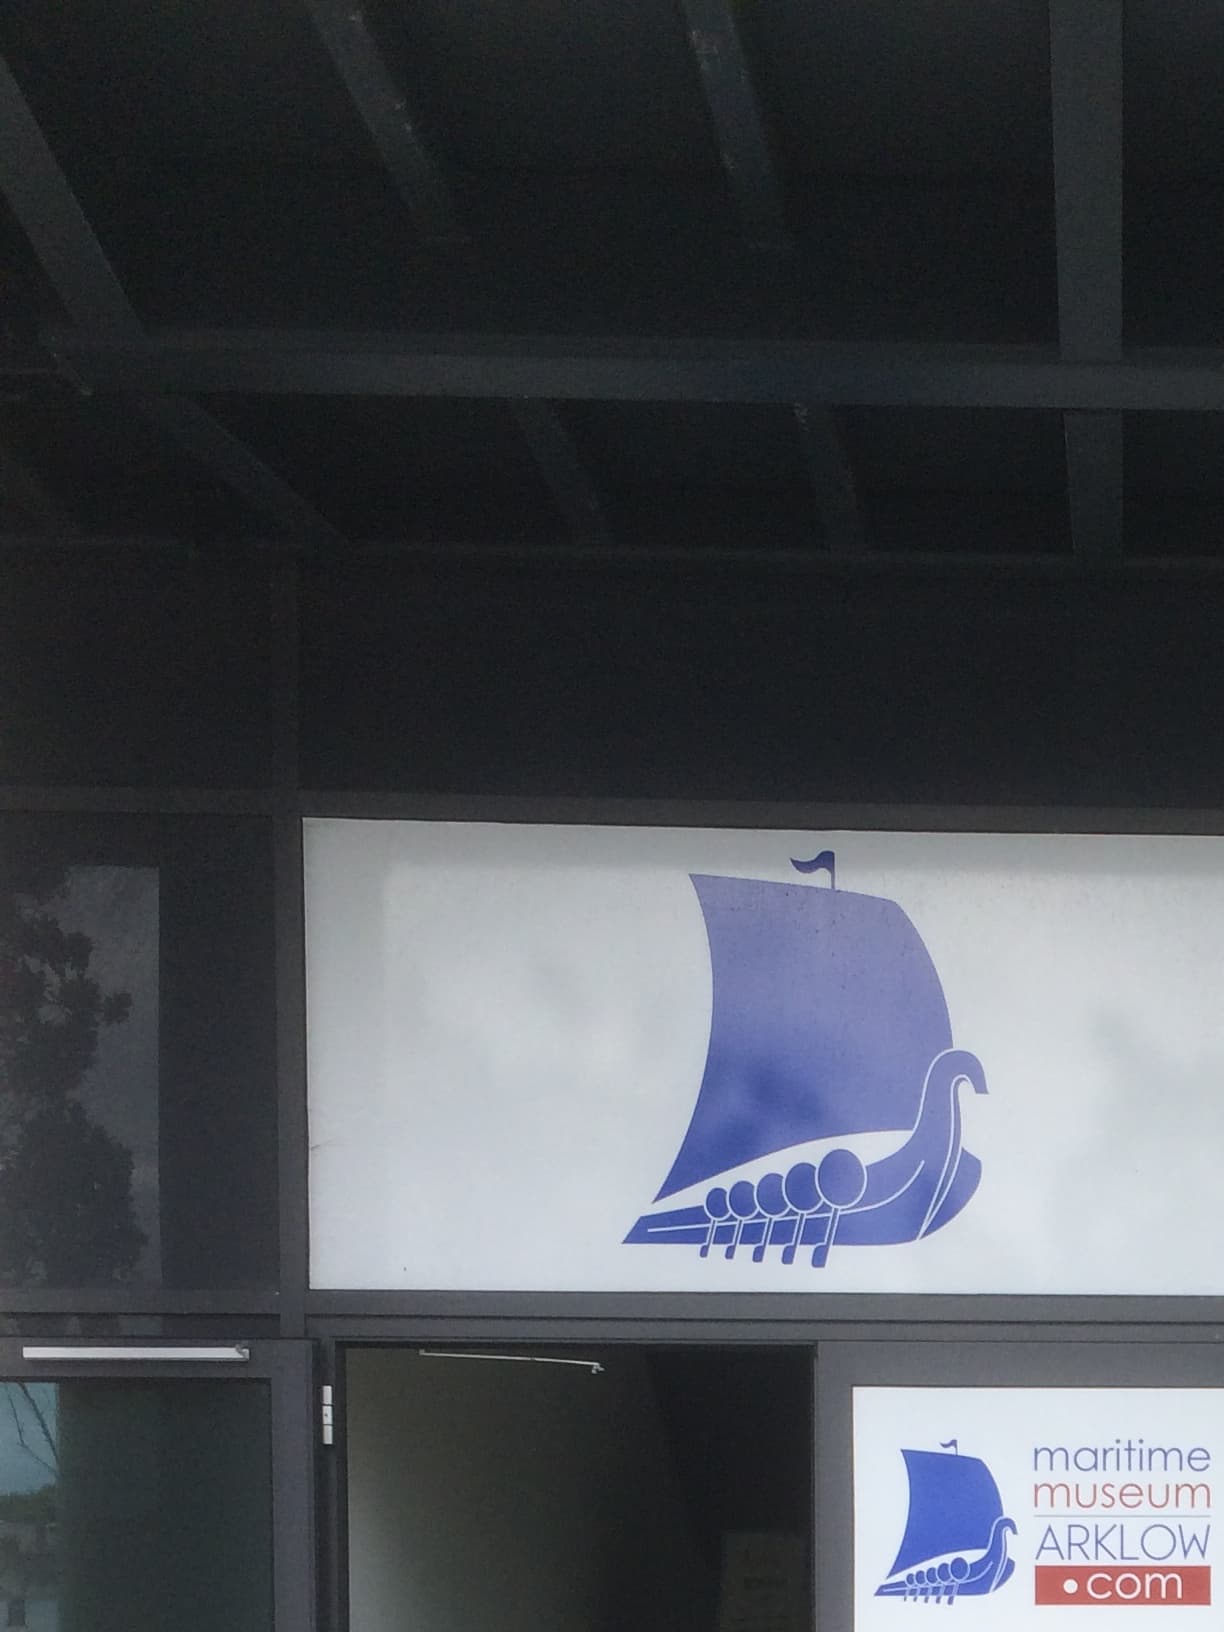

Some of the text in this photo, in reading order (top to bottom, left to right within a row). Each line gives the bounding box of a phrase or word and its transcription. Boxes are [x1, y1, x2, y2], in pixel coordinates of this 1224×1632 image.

[1033, 1438, 1211, 1472] maritime
[1033, 1482, 1211, 1509] museum
[1034, 1523, 1211, 1561] ARKLOW
[1063, 1572, 1183, 1600] .com
